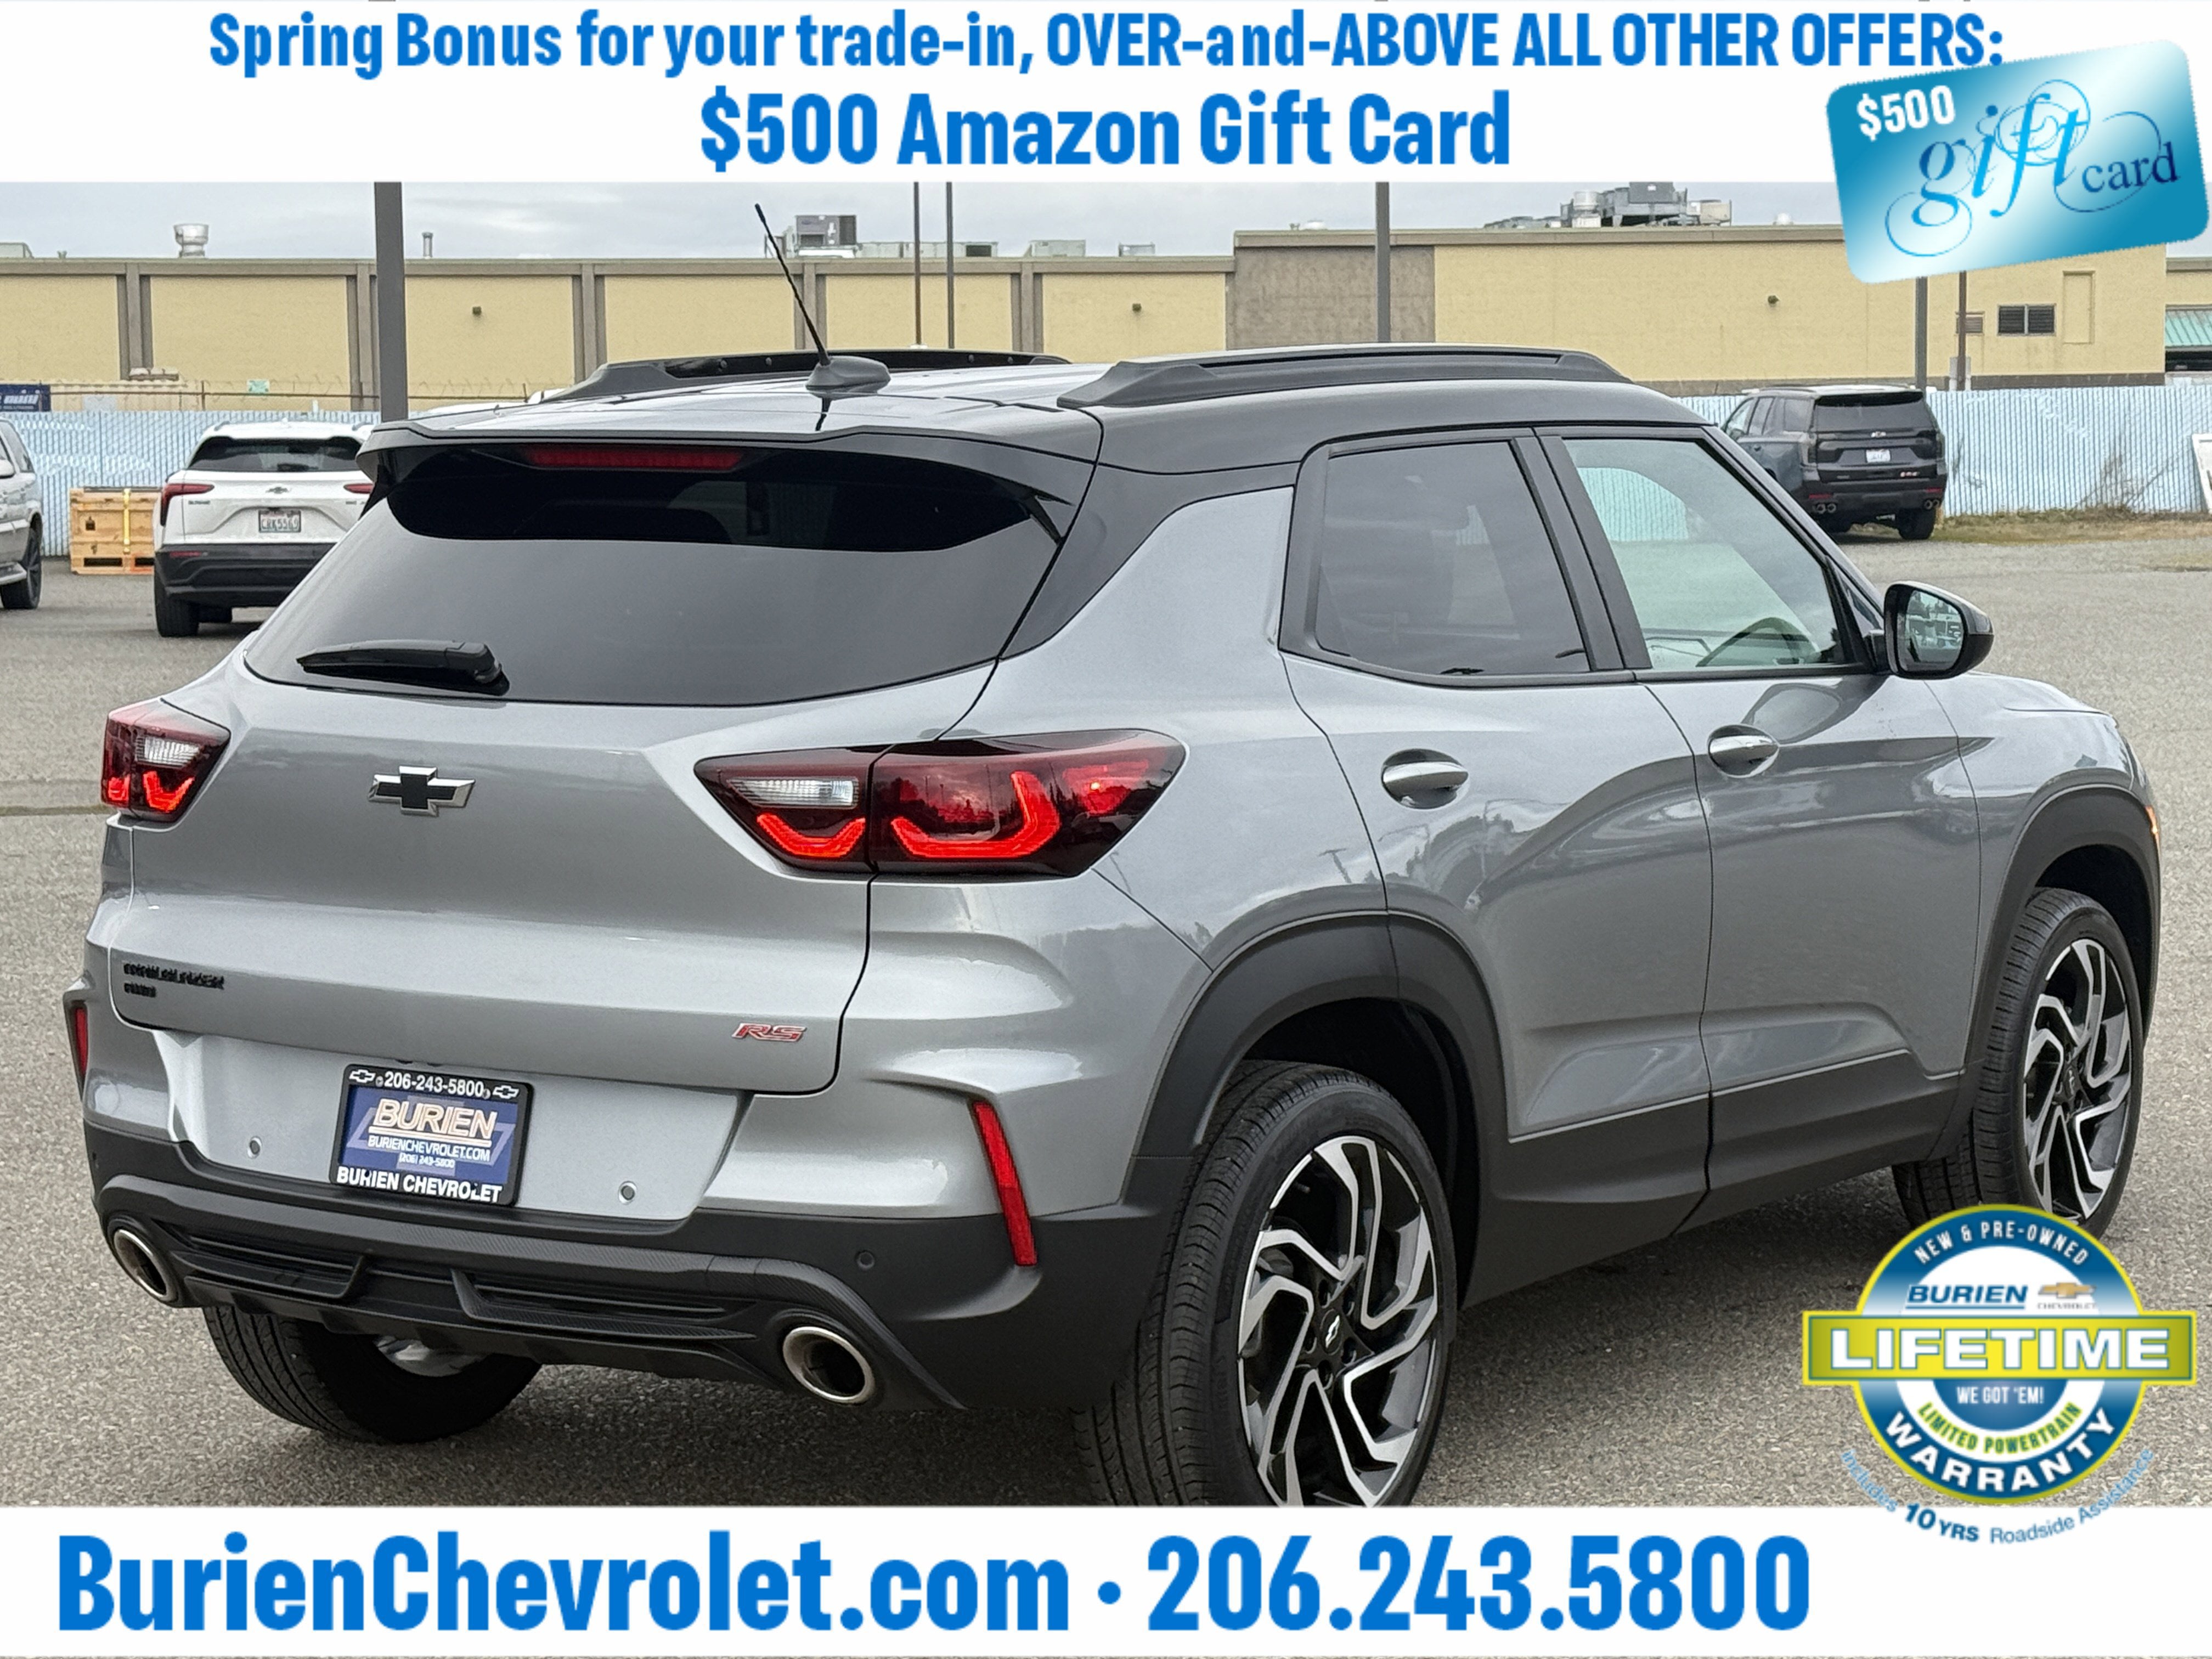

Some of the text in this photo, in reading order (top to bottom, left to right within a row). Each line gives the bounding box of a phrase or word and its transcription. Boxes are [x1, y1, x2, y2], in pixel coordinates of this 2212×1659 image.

[731, 1023, 808, 1042] RS
[385, 1070, 484, 1097] 206-243-5800
[373, 1098, 498, 1139] BURIEN
[367, 1135, 491, 1163] BURIENCHEVROLET.COM
[403, 1173, 503, 1203] CHEVROLET
